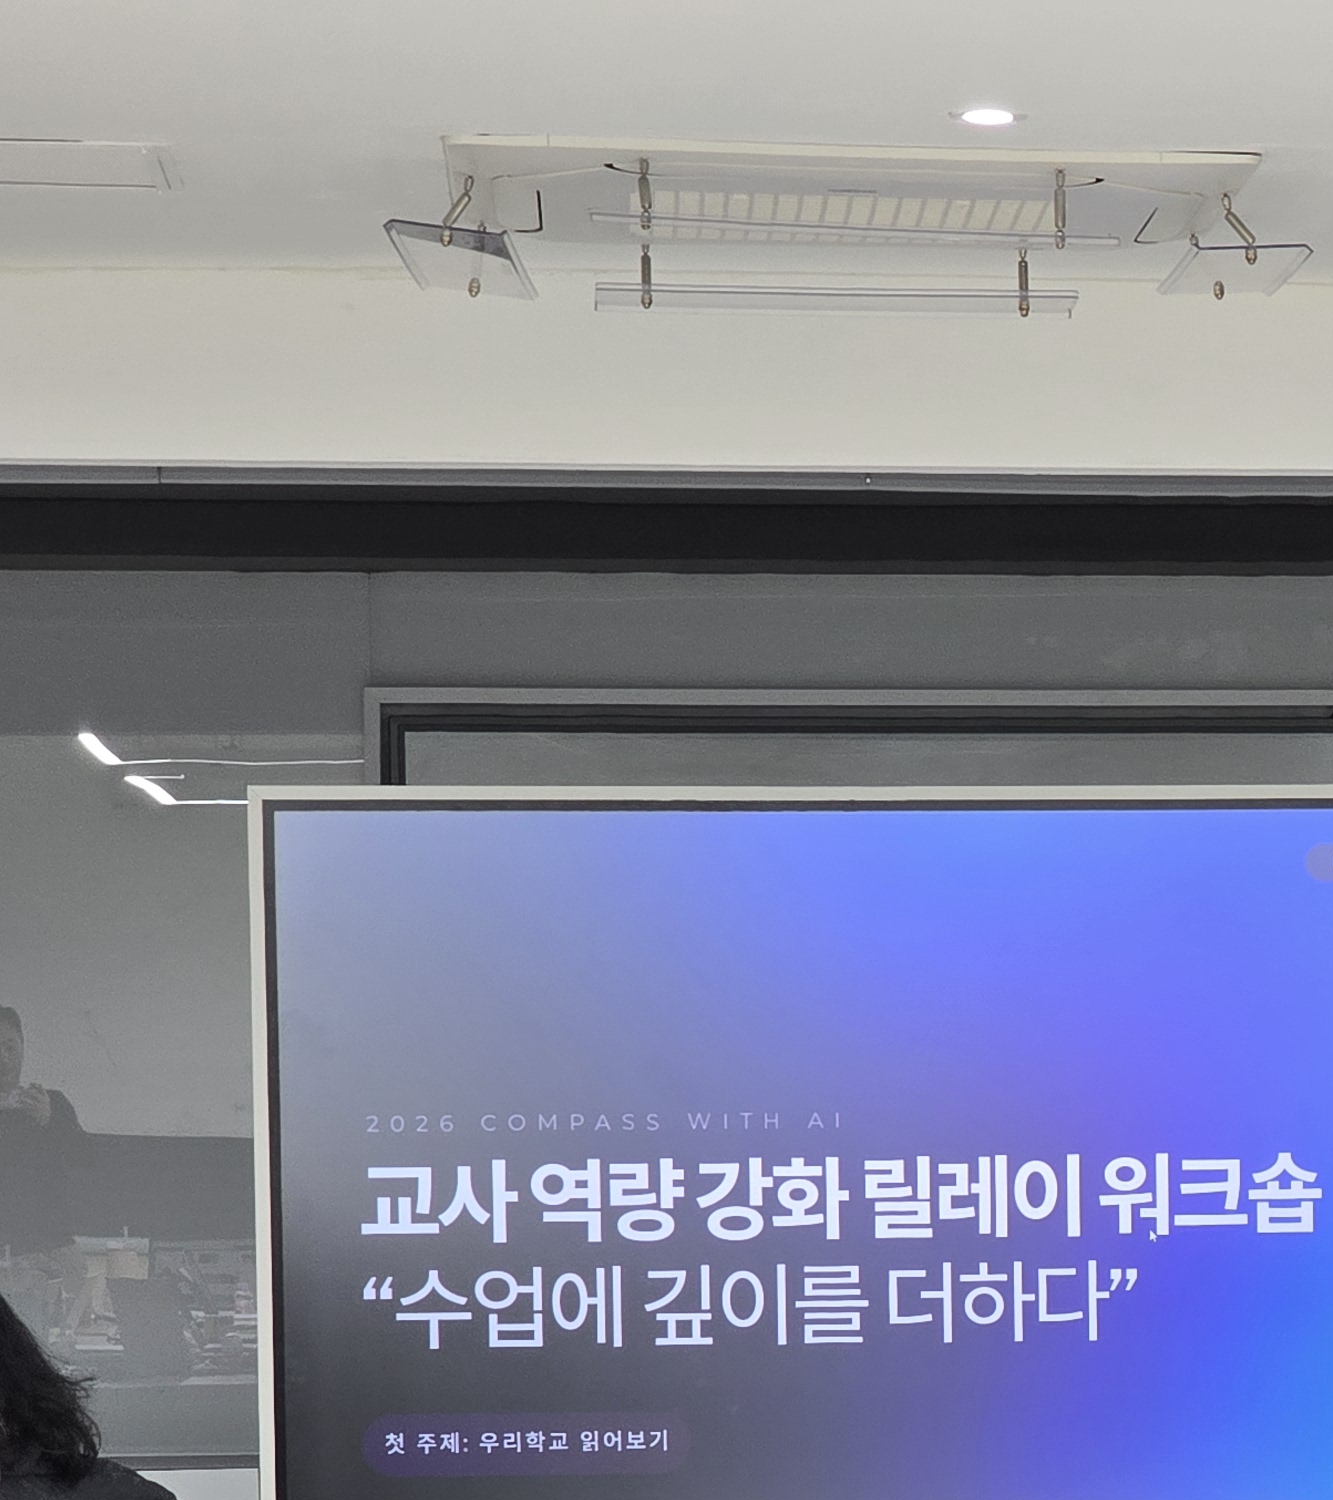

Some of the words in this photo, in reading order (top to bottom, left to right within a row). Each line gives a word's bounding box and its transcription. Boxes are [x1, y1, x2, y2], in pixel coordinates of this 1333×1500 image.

[365, 1114, 455, 1133] 2026
[480, 1113, 660, 1132] COMPASS
[687, 1112, 780, 1130] WITH
[807, 1111, 840, 1129] AI
[360, 1158, 519, 1243] 교사
[530, 1157, 685, 1243] 역량
[696, 1156, 850, 1241] 강화
[863, 1153, 1081, 1239] 릴레이
[1098, 1152, 1323, 1236] 워크숍
[362, 1265, 623, 1350] “수업에
[644, 1263, 870, 1346] 깊이를
[888, 1259, 1138, 1343] 더하다”
[384, 1432, 405, 1455] 첫
[416, 1431, 469, 1455] 주제:
[479, 1430, 569, 1453] 우리학교
[580, 1429, 669, 1452] 읽어보기
